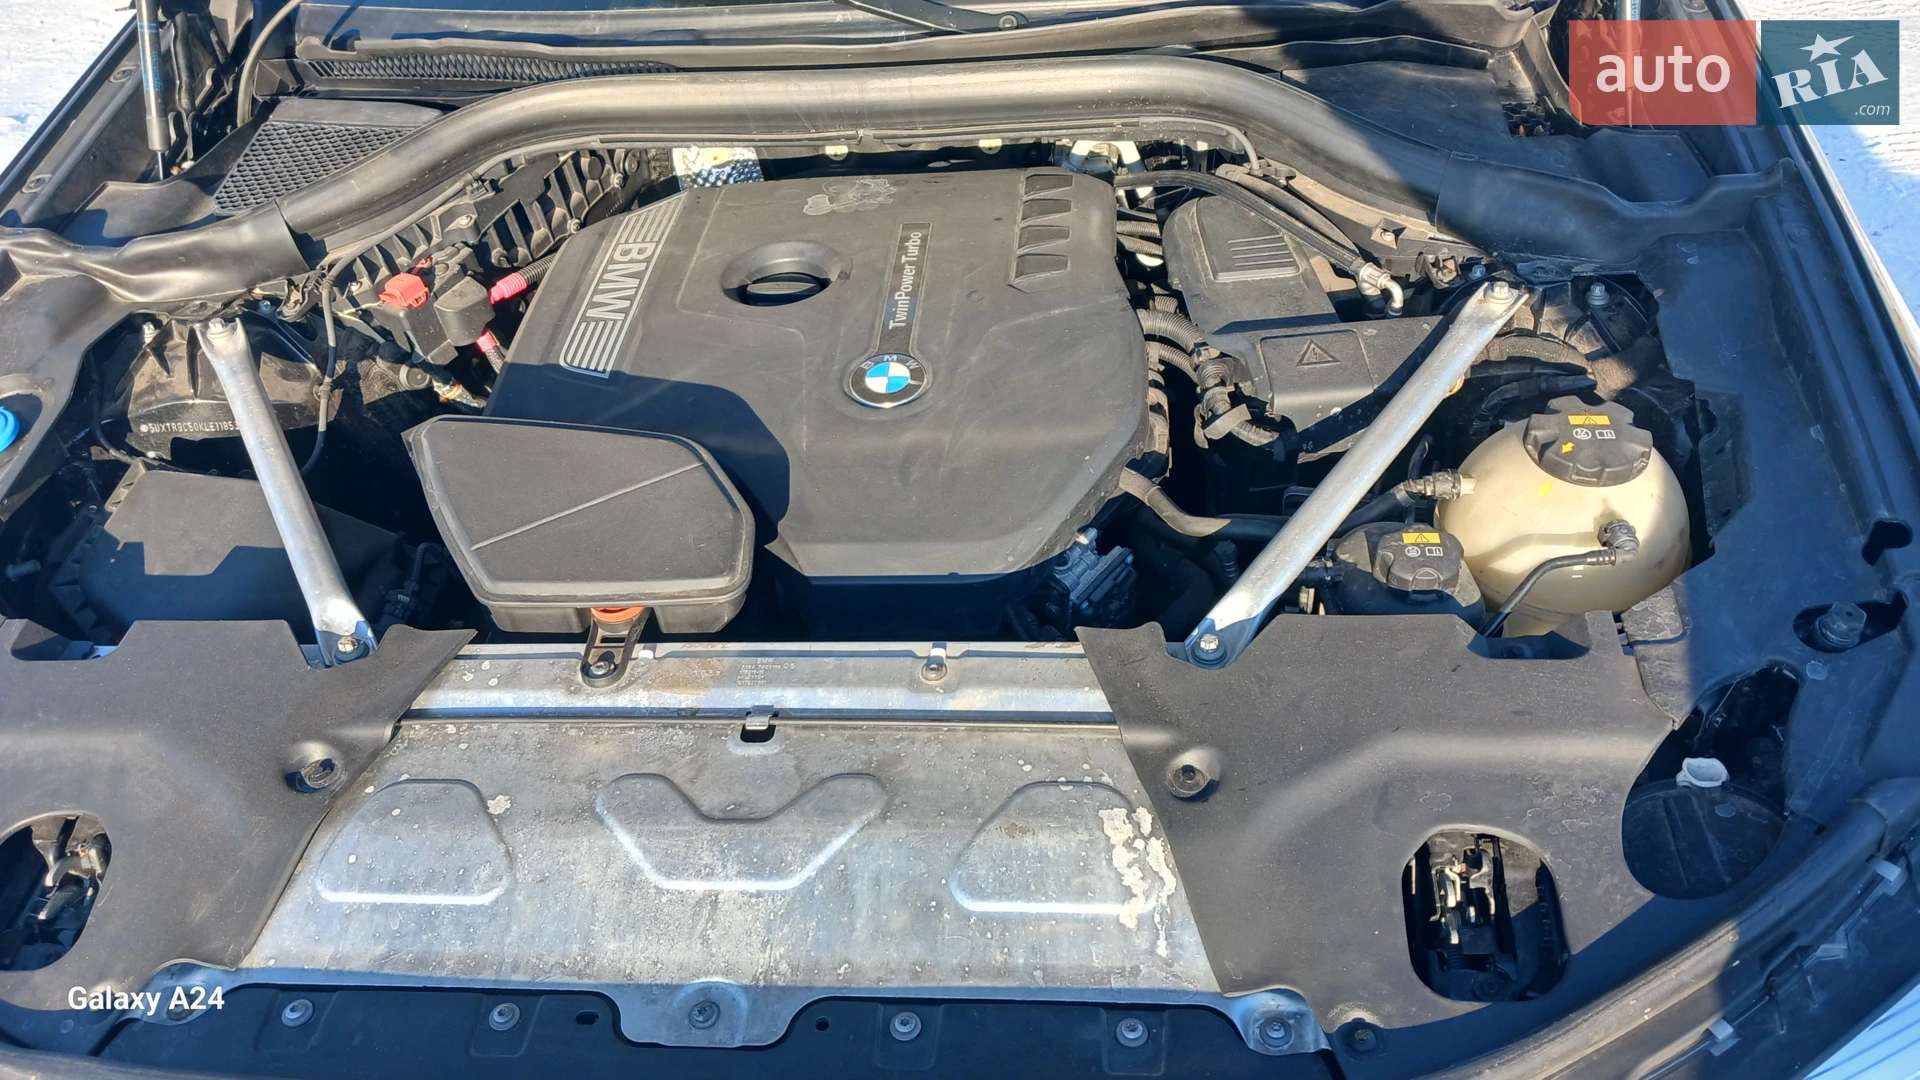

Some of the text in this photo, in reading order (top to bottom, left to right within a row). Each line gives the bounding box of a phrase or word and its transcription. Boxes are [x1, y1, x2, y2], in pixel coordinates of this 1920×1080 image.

[586, 241, 658, 320] BMW
[888, 231, 922, 330] TwinPower Turbo
